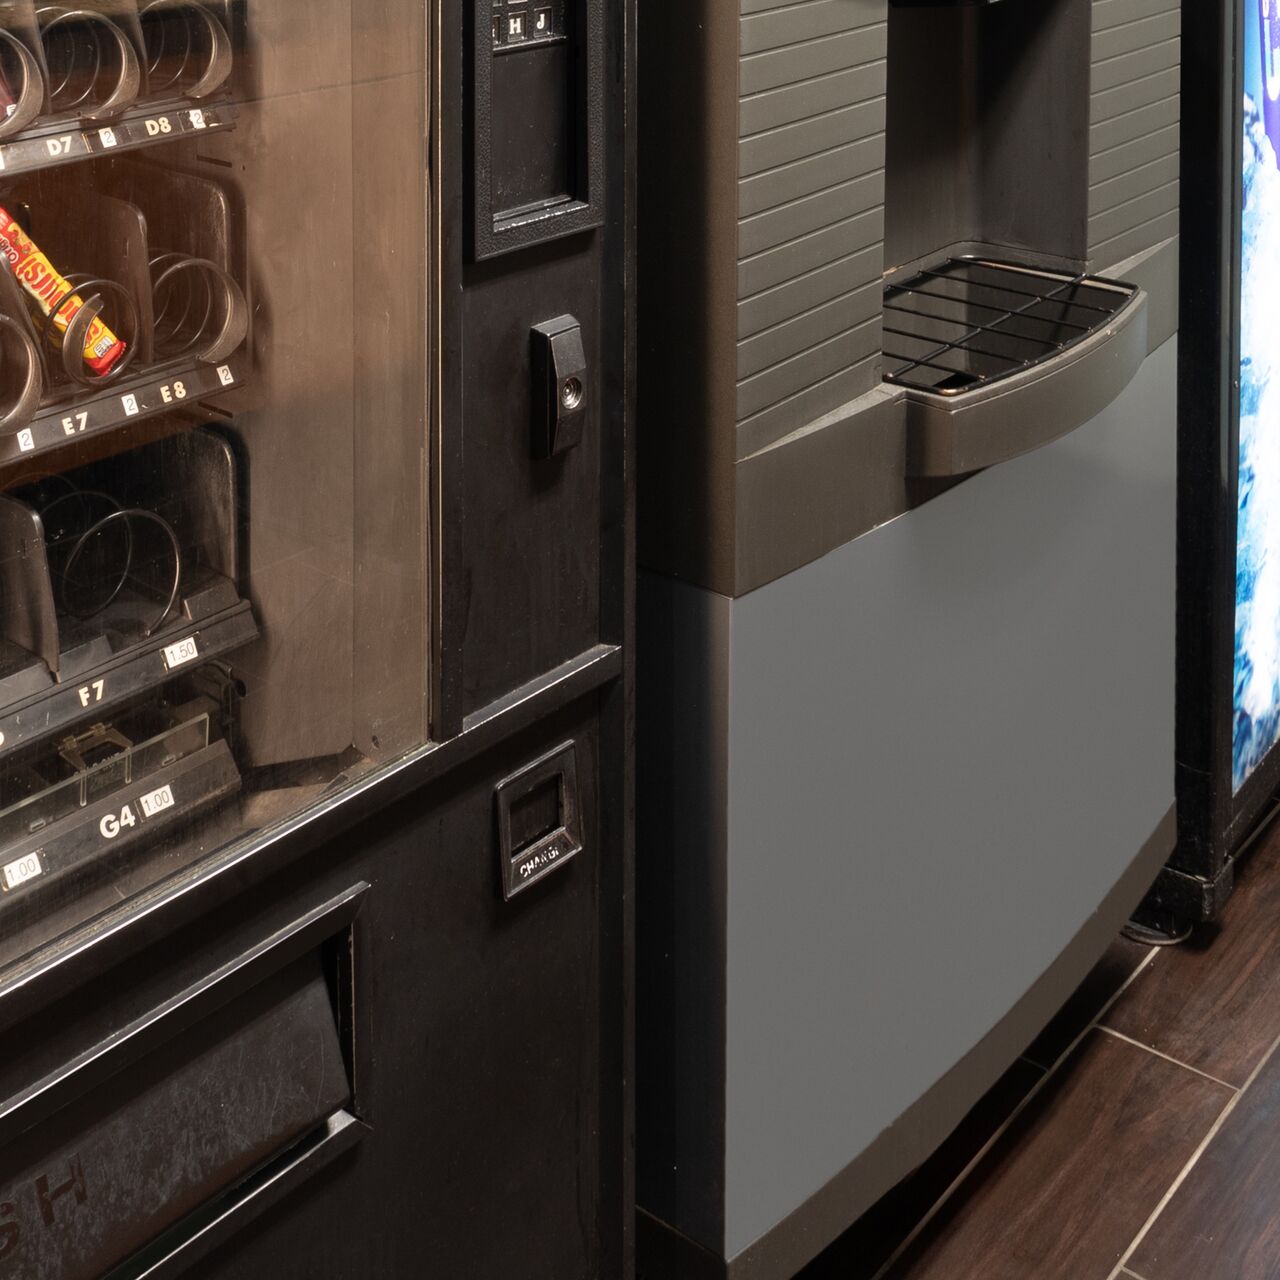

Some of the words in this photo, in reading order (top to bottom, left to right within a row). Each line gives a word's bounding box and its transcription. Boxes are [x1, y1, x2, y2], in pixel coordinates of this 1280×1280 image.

[509, 19, 521, 35] H
[537, 14, 545, 30] J
[145, 117, 172, 135] D8
[194, 113, 203, 125] 2
[46, 137, 73, 157] D7
[104, 131, 114, 144] 2
[221, 367, 231, 382] 2
[160, 382, 187, 404] E8
[126, 398, 136, 412] 2
[62, 413, 89, 435] E7
[21, 432, 31, 447] 2
[170, 641, 195, 662] 1.50
[79, 681, 105, 707] F7
[143, 790, 170, 813] 1.00
[100, 807, 136, 839] G4
[7, 857, 36, 883] 1.00
